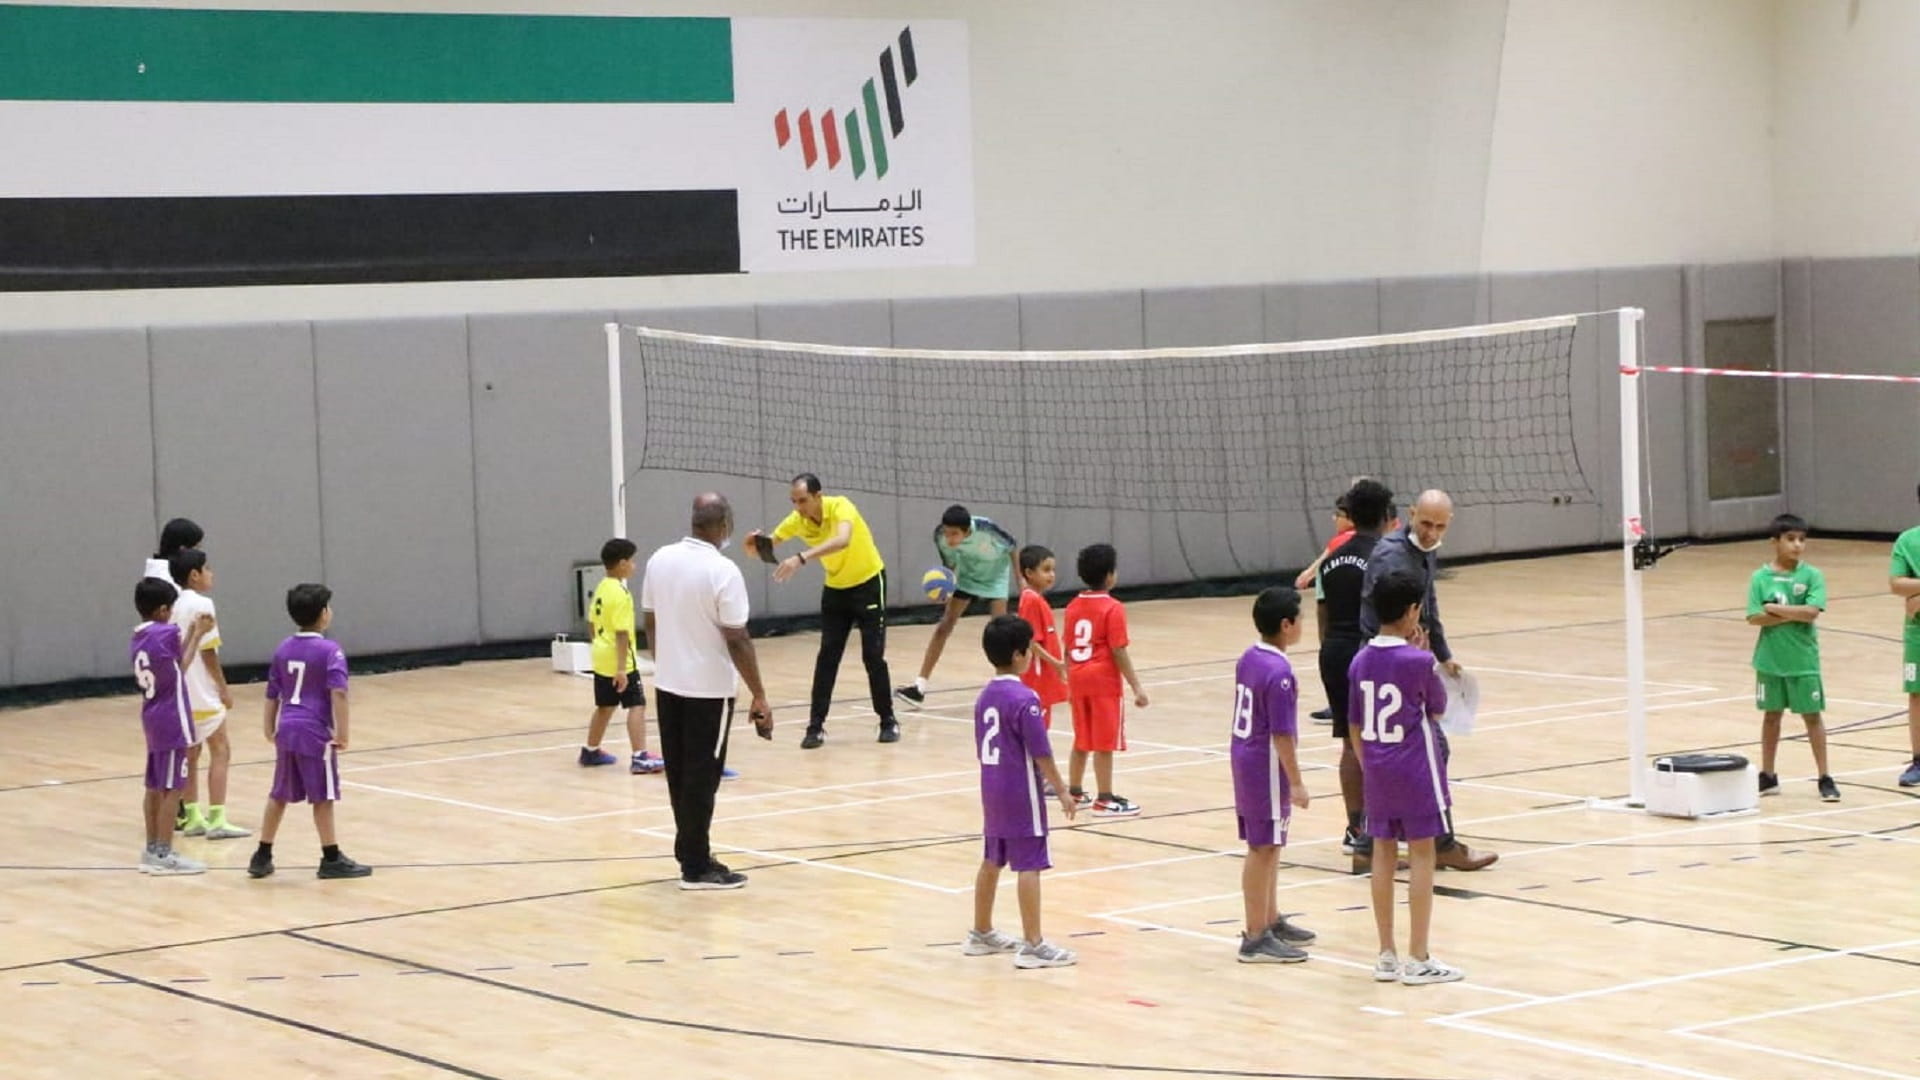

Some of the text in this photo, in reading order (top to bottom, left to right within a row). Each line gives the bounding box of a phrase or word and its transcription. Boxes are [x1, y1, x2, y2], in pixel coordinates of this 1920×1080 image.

[777, 188, 921, 219] الإمارات
[777, 225, 924, 251] THE EMIRATES
[1071, 618, 1094, 662] 3
[134, 650, 156, 700] 6
[287, 661, 306, 705] 7
[1233, 683, 1254, 739] 13
[1359, 680, 1405, 744] 12
[981, 706, 1001, 766] 2
[180, 757, 189, 778] 6
